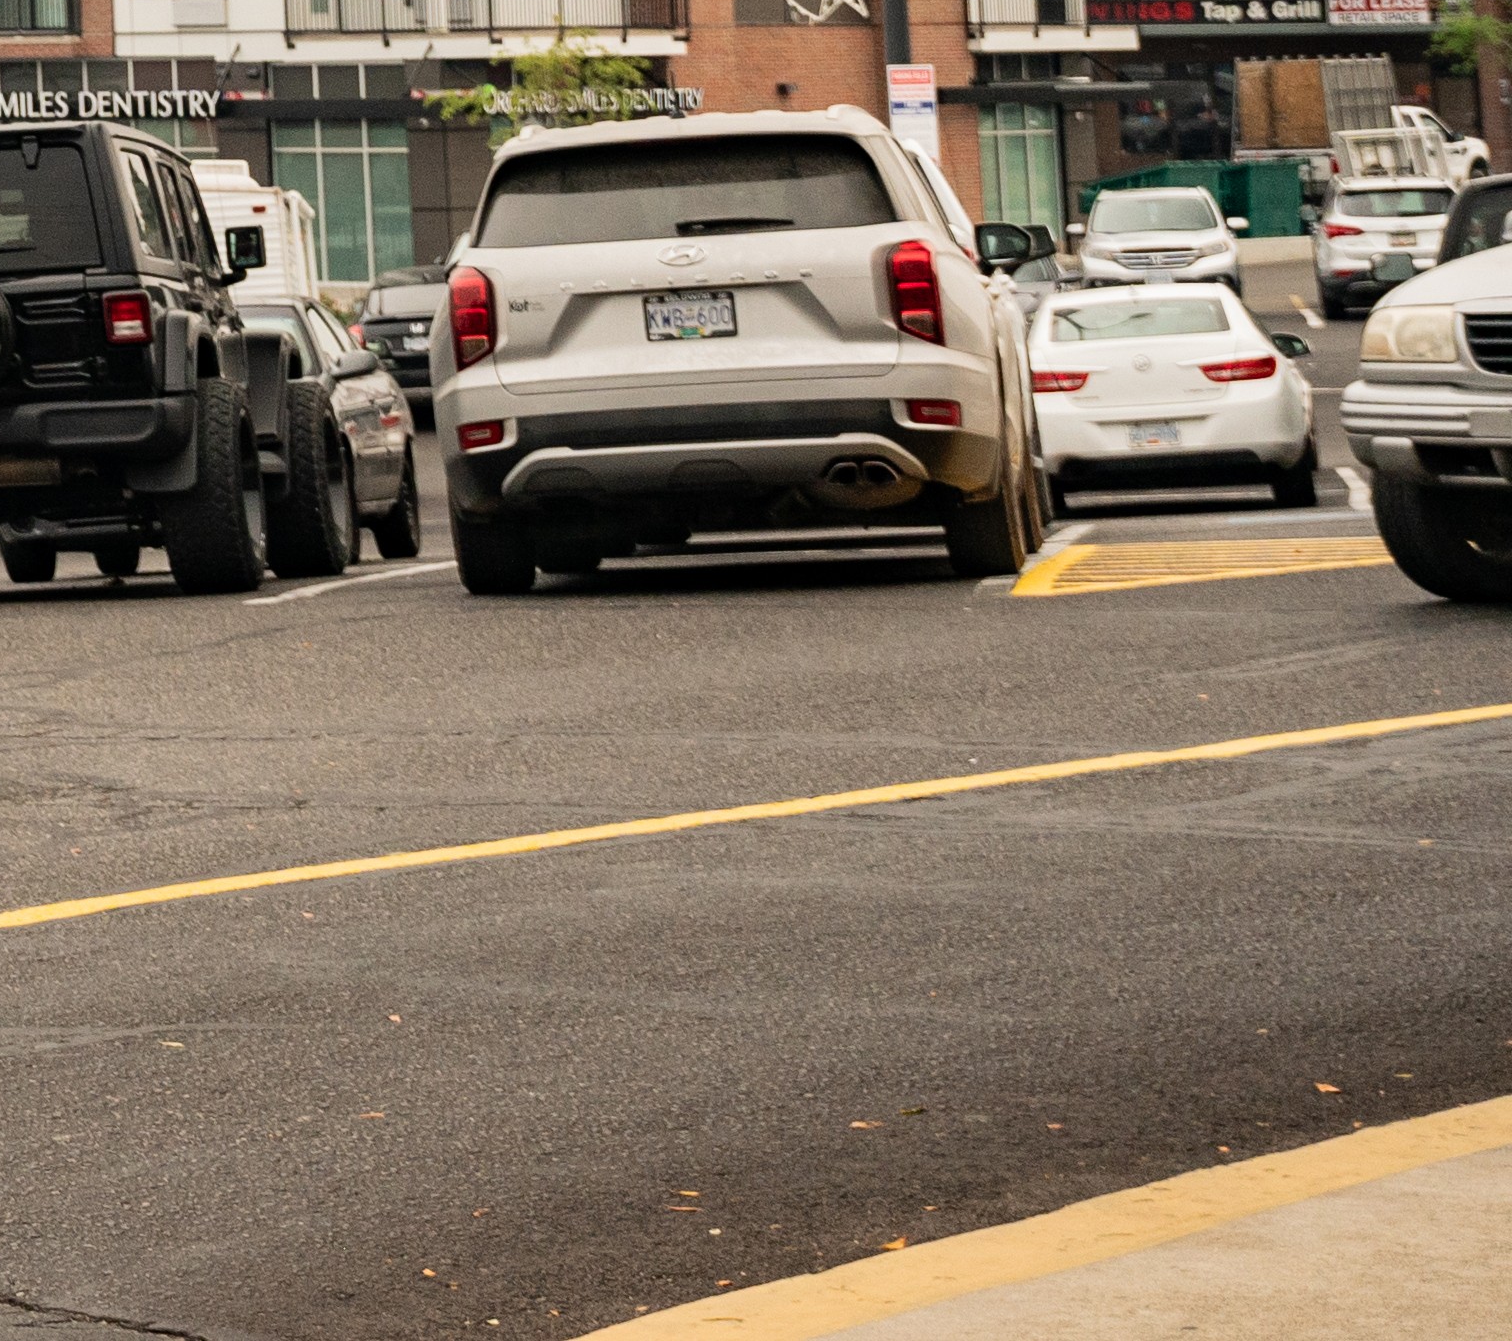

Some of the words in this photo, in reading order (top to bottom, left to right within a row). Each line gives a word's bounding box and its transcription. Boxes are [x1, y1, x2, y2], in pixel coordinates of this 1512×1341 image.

[1200, 0, 1243, 23] Tap
[1246, 0, 1269, 20] &
[1271, 0, 1322, 20] Grill
[1337, 11, 1379, 23] RETAIL
[1381, 11, 1419, 22] SPACE
[78, 90, 221, 118] DENTISTRY
